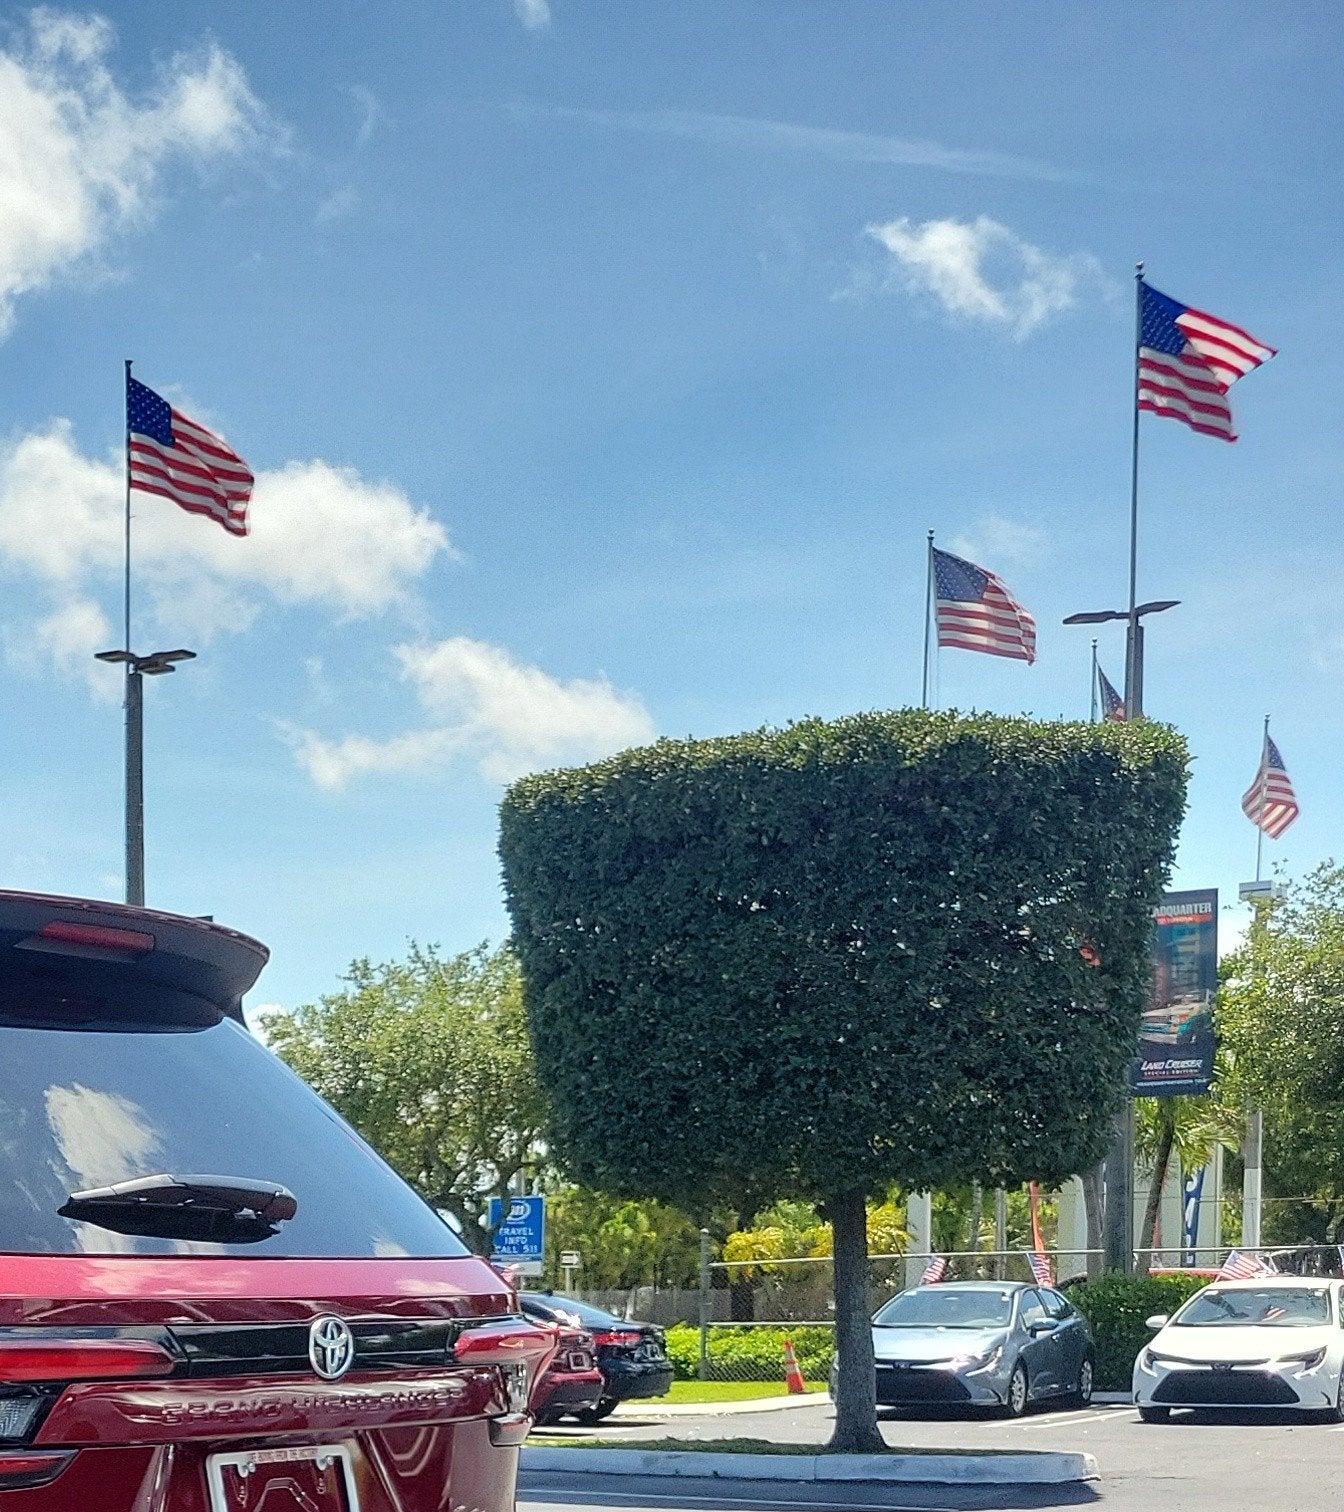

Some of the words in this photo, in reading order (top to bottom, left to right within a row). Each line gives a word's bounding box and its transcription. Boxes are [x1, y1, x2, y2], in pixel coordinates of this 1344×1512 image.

[1153, 902, 1212, 917] ADQUARTER
[505, 1236, 528, 1245] INFO
[522, 1244, 538, 1254] 511
[161, 1397, 282, 1427] GRAND
[293, 1388, 464, 1413] HIGHLANDER
